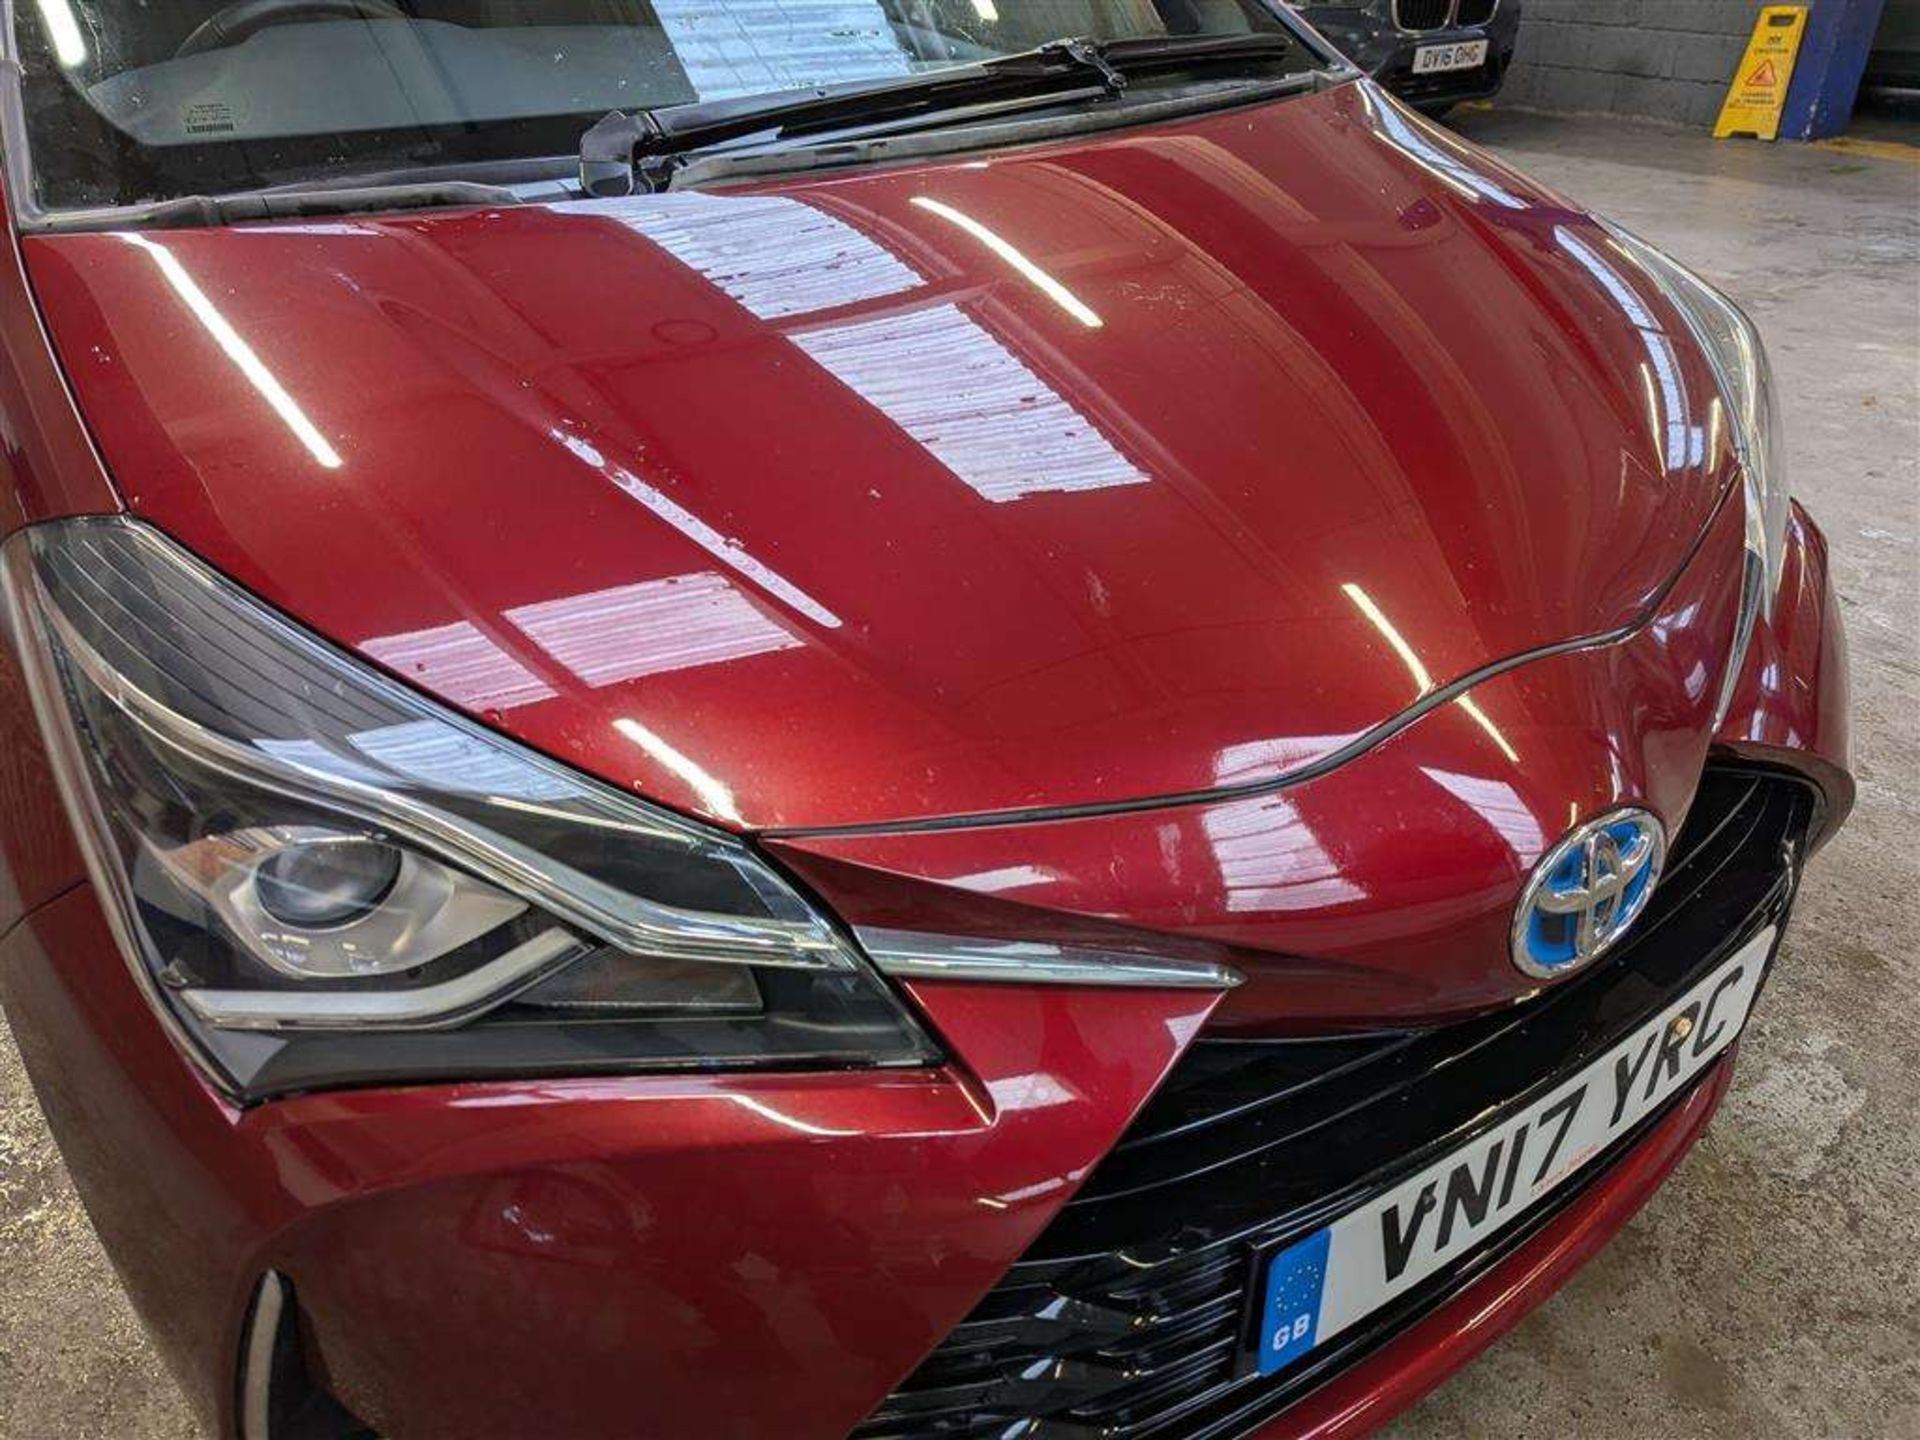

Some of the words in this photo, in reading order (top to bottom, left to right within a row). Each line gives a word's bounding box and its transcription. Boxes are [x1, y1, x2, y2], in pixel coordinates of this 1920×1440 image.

[1381, 1083, 1588, 1283] VN17
[1608, 966, 1744, 1129] YRC
[1272, 1313, 1311, 1351] GB
